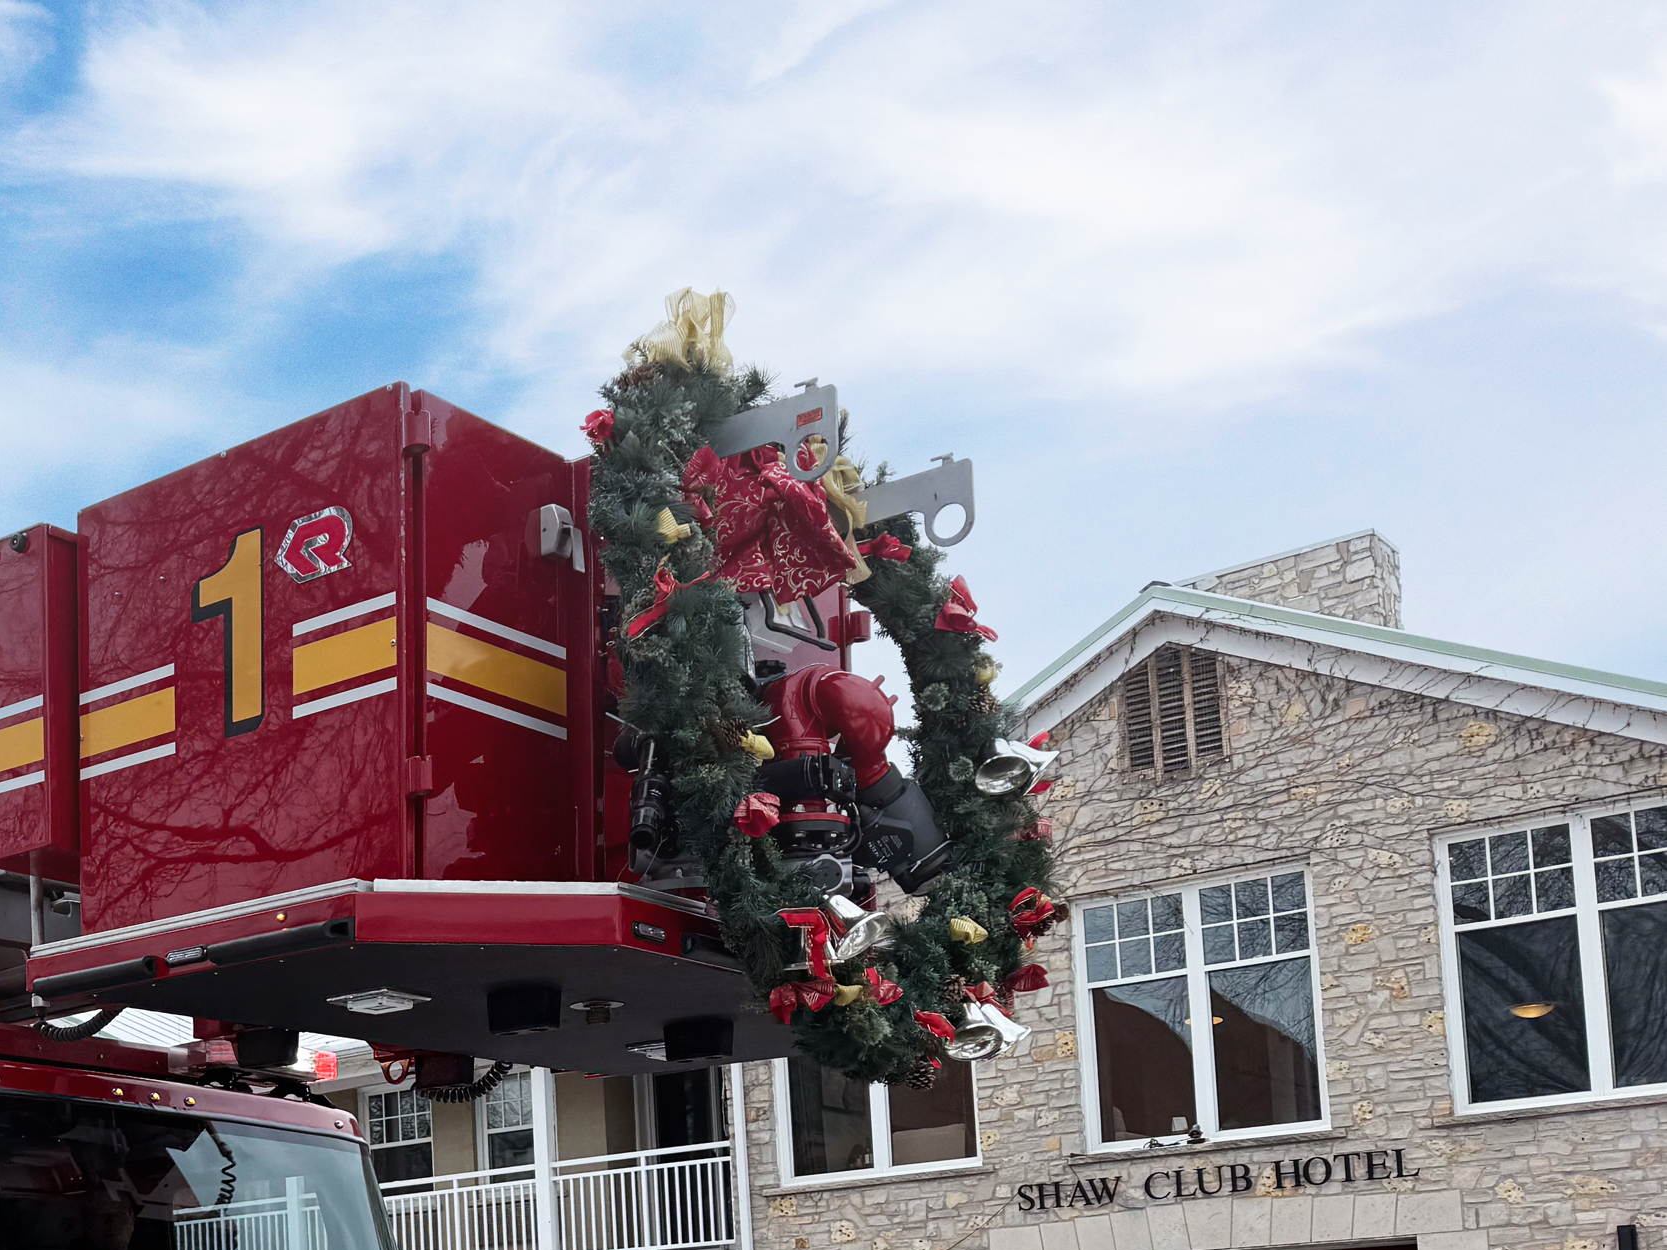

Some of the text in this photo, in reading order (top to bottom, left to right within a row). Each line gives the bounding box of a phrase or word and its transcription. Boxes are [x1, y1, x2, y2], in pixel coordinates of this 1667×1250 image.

[191, 524, 265, 738] 1
[1017, 1148, 1421, 1211] SHAW CLUB HOTEL
